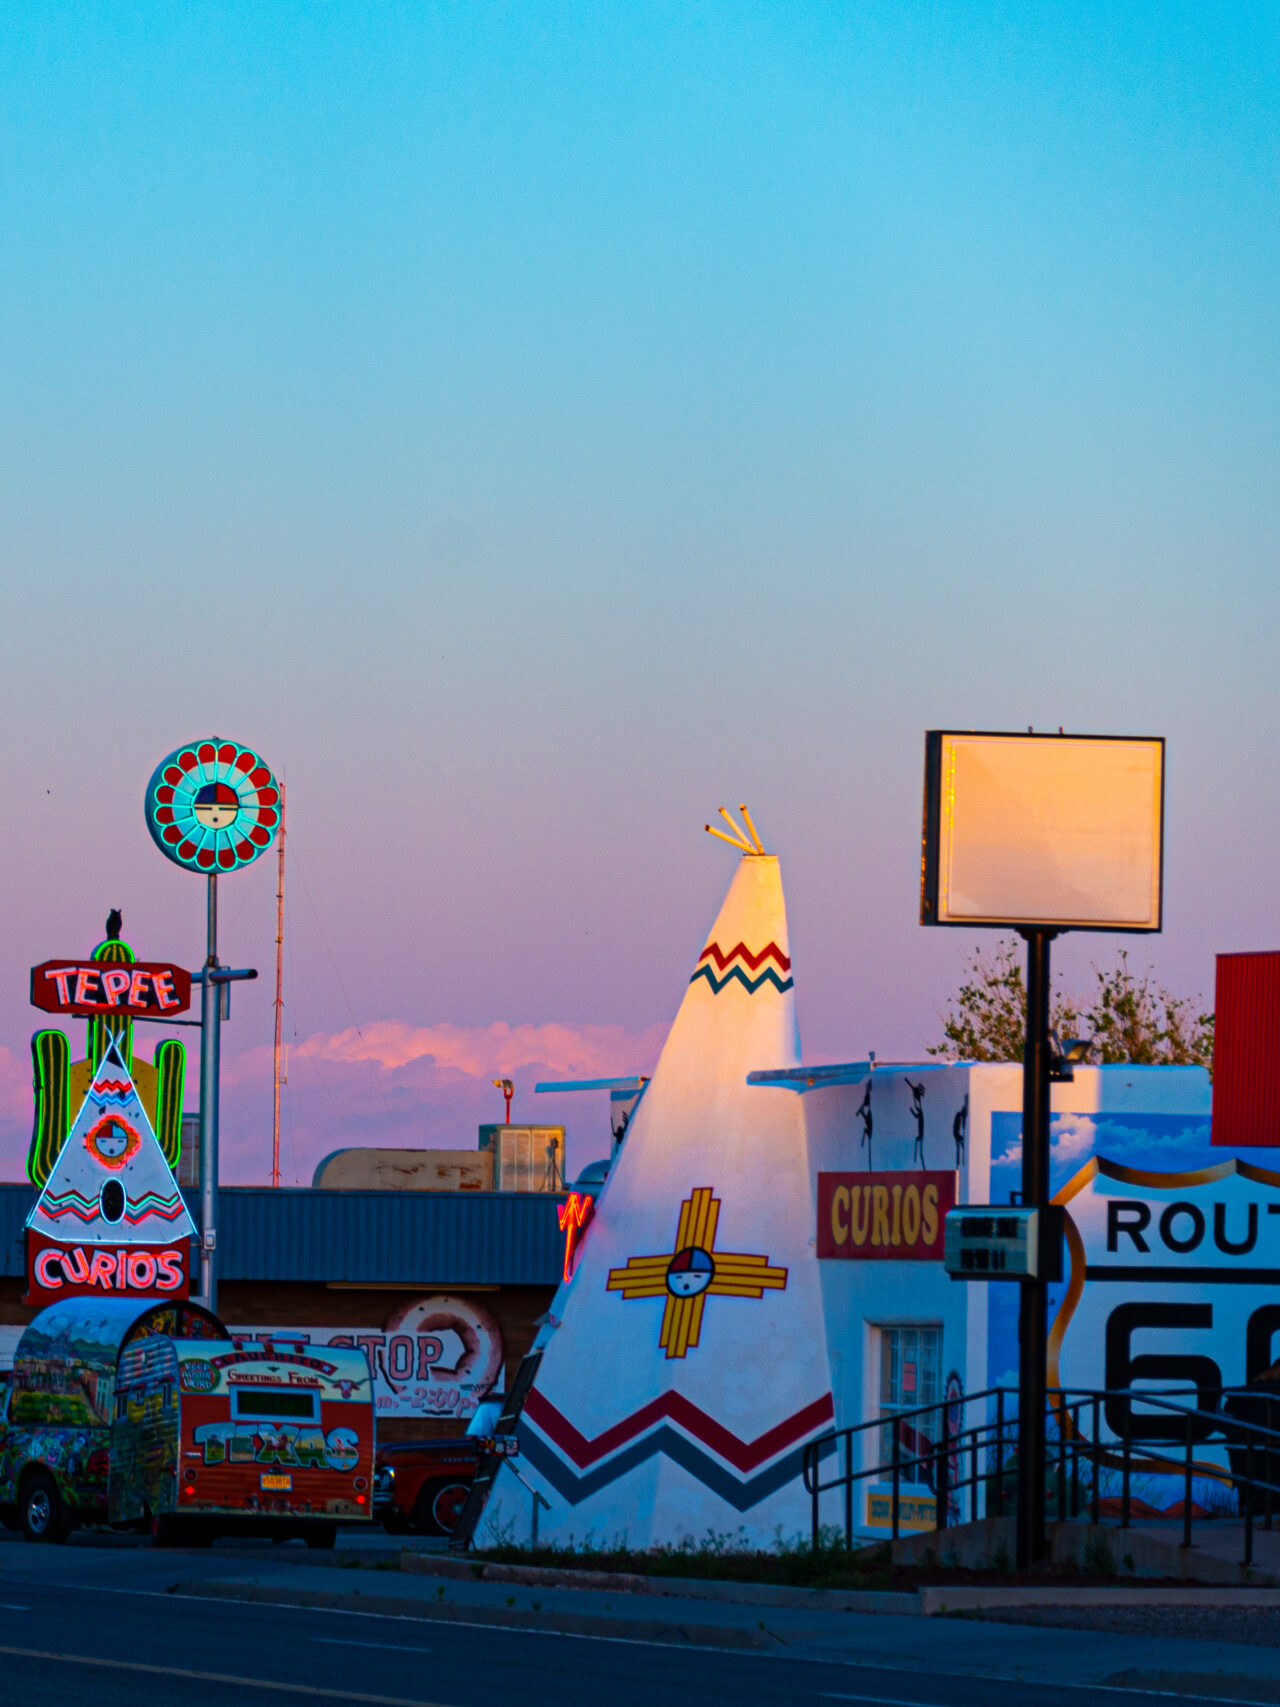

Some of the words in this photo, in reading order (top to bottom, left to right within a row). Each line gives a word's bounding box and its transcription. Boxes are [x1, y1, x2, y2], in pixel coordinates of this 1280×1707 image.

[45, 967, 180, 1010] TEPEE
[831, 1183, 939, 1247] CURIOS
[34, 1247, 184, 1291] CURIOS
[193, 1421, 359, 1472] TEXAS
